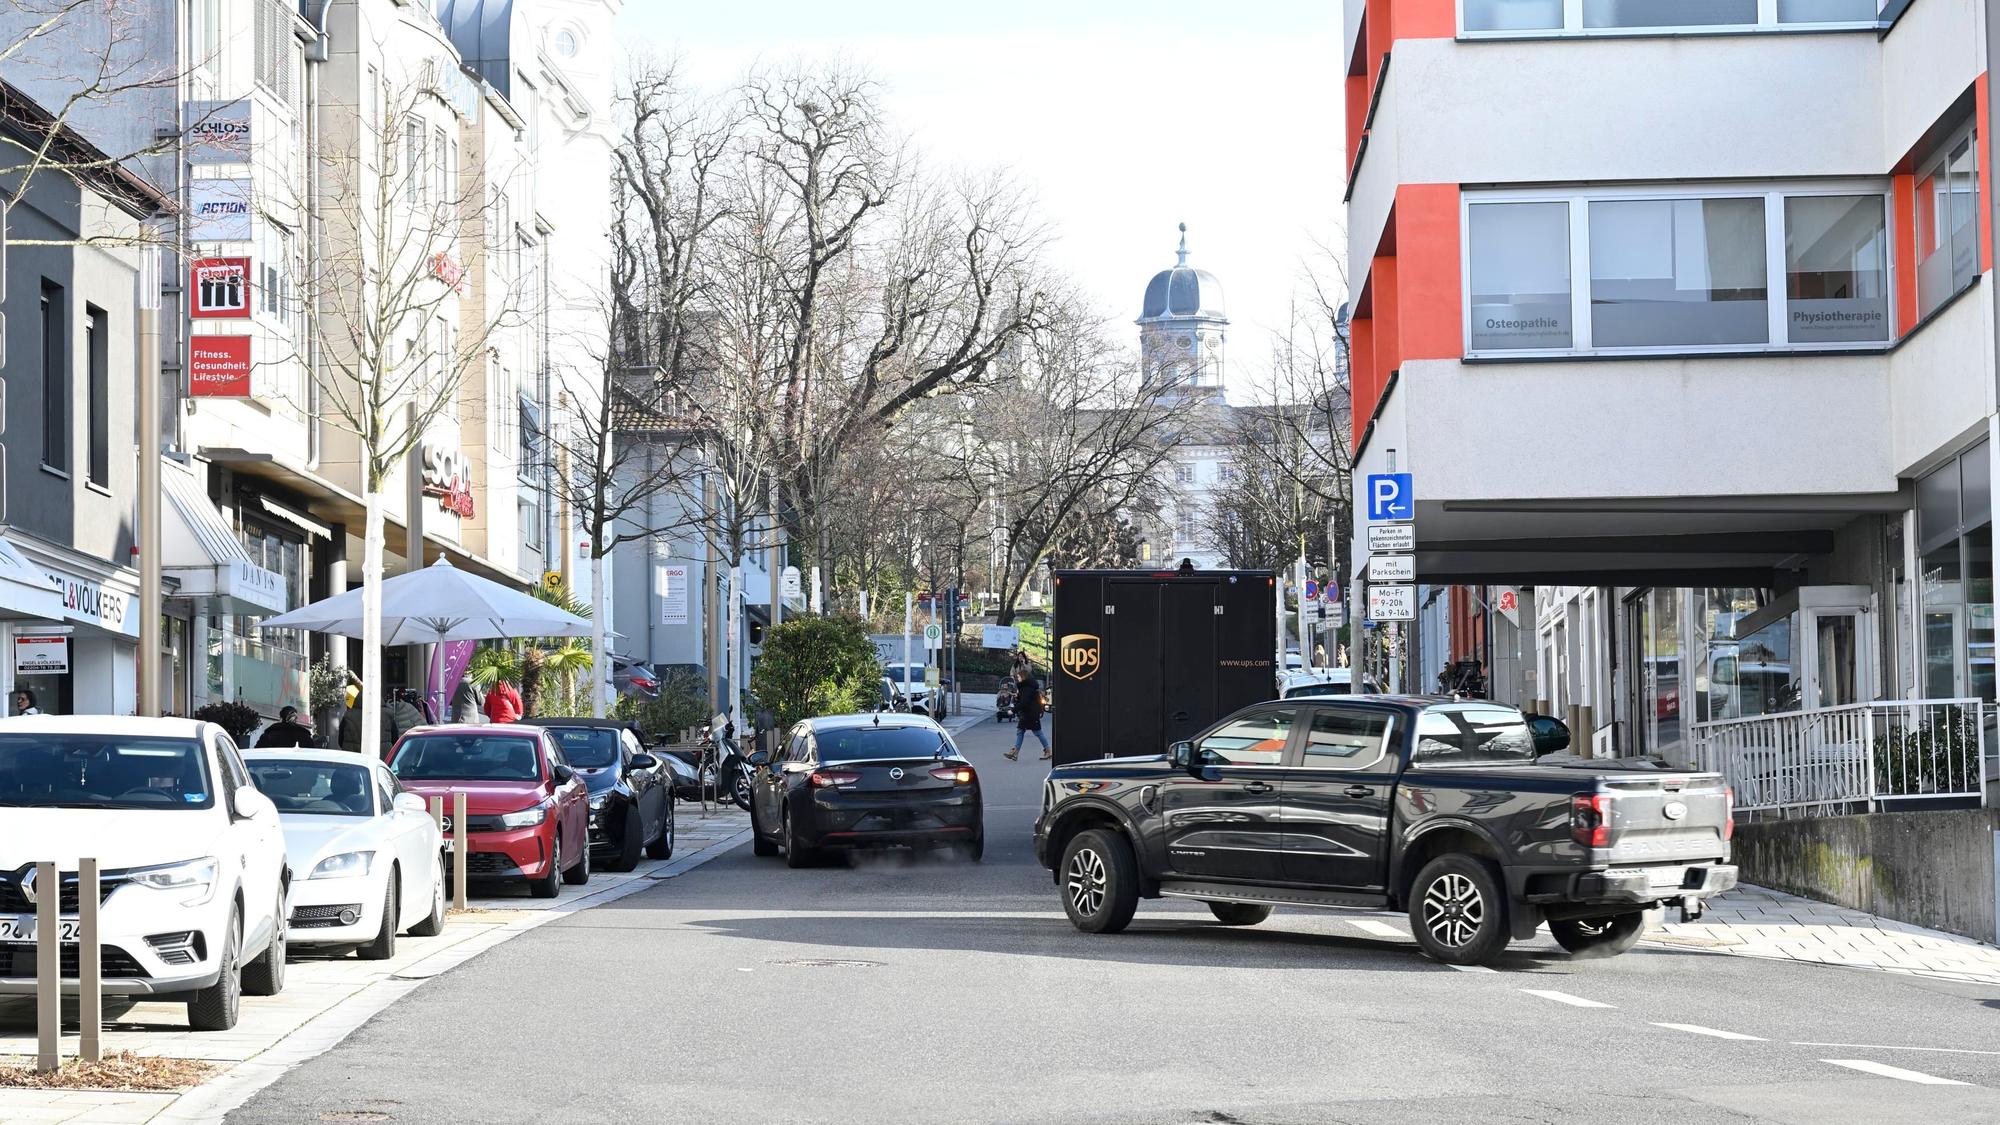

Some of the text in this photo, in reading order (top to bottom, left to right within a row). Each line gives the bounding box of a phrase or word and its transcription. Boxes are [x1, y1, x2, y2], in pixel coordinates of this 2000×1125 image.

[193, 121, 249, 133] SCHLOSS
[201, 202, 247, 214] ACTION
[200, 276, 240, 307] fit
[1793, 310, 1882, 324] Physiotherapie
[1486, 317, 1558, 330] Osteopathie
[194, 350, 232, 359] Fitness.
[193, 362, 249, 370] Gesundheit.
[1374, 479, 1399, 515] P
[1370, 535, 1412, 543] gekennzeichneten
[1375, 609, 1410, 617] Sa 9-14h
[1062, 648, 1098, 673] ups
[1219, 659, 1270, 668] www.ups.com
